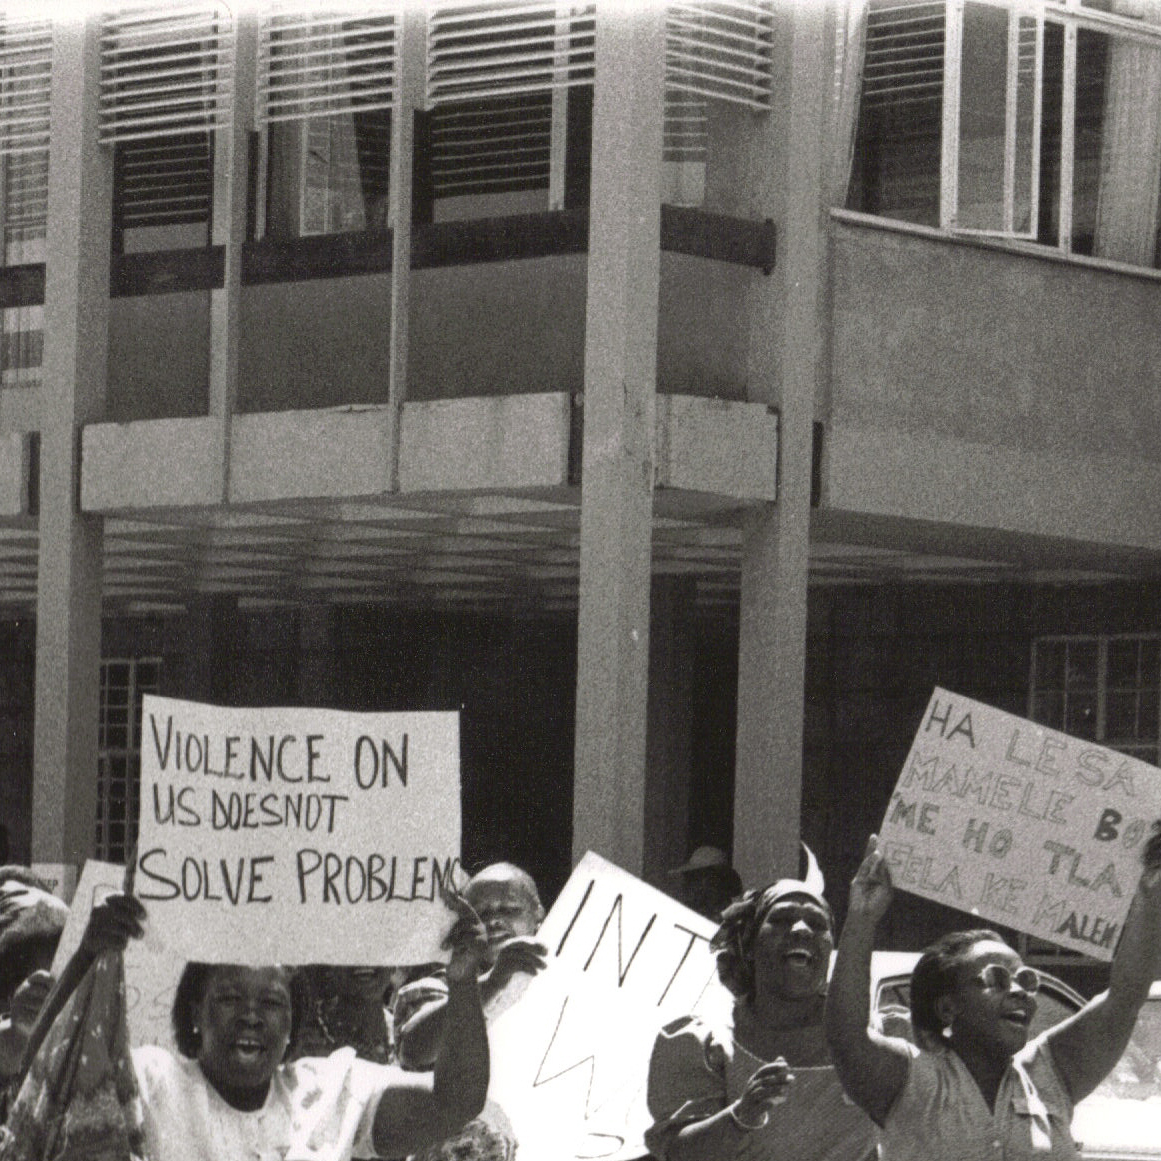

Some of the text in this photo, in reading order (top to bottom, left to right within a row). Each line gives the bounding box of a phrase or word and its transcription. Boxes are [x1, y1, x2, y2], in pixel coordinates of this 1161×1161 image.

[149, 713, 409, 789] VIOLENCE ON
[924, 699, 976, 749] HA
[151, 782, 202, 827] US
[900, 750, 1076, 826] MAMELE
[139, 848, 275, 906] SOLVE
[961, 817, 1014, 859] HO
[1042, 839, 1124, 899] TLA
